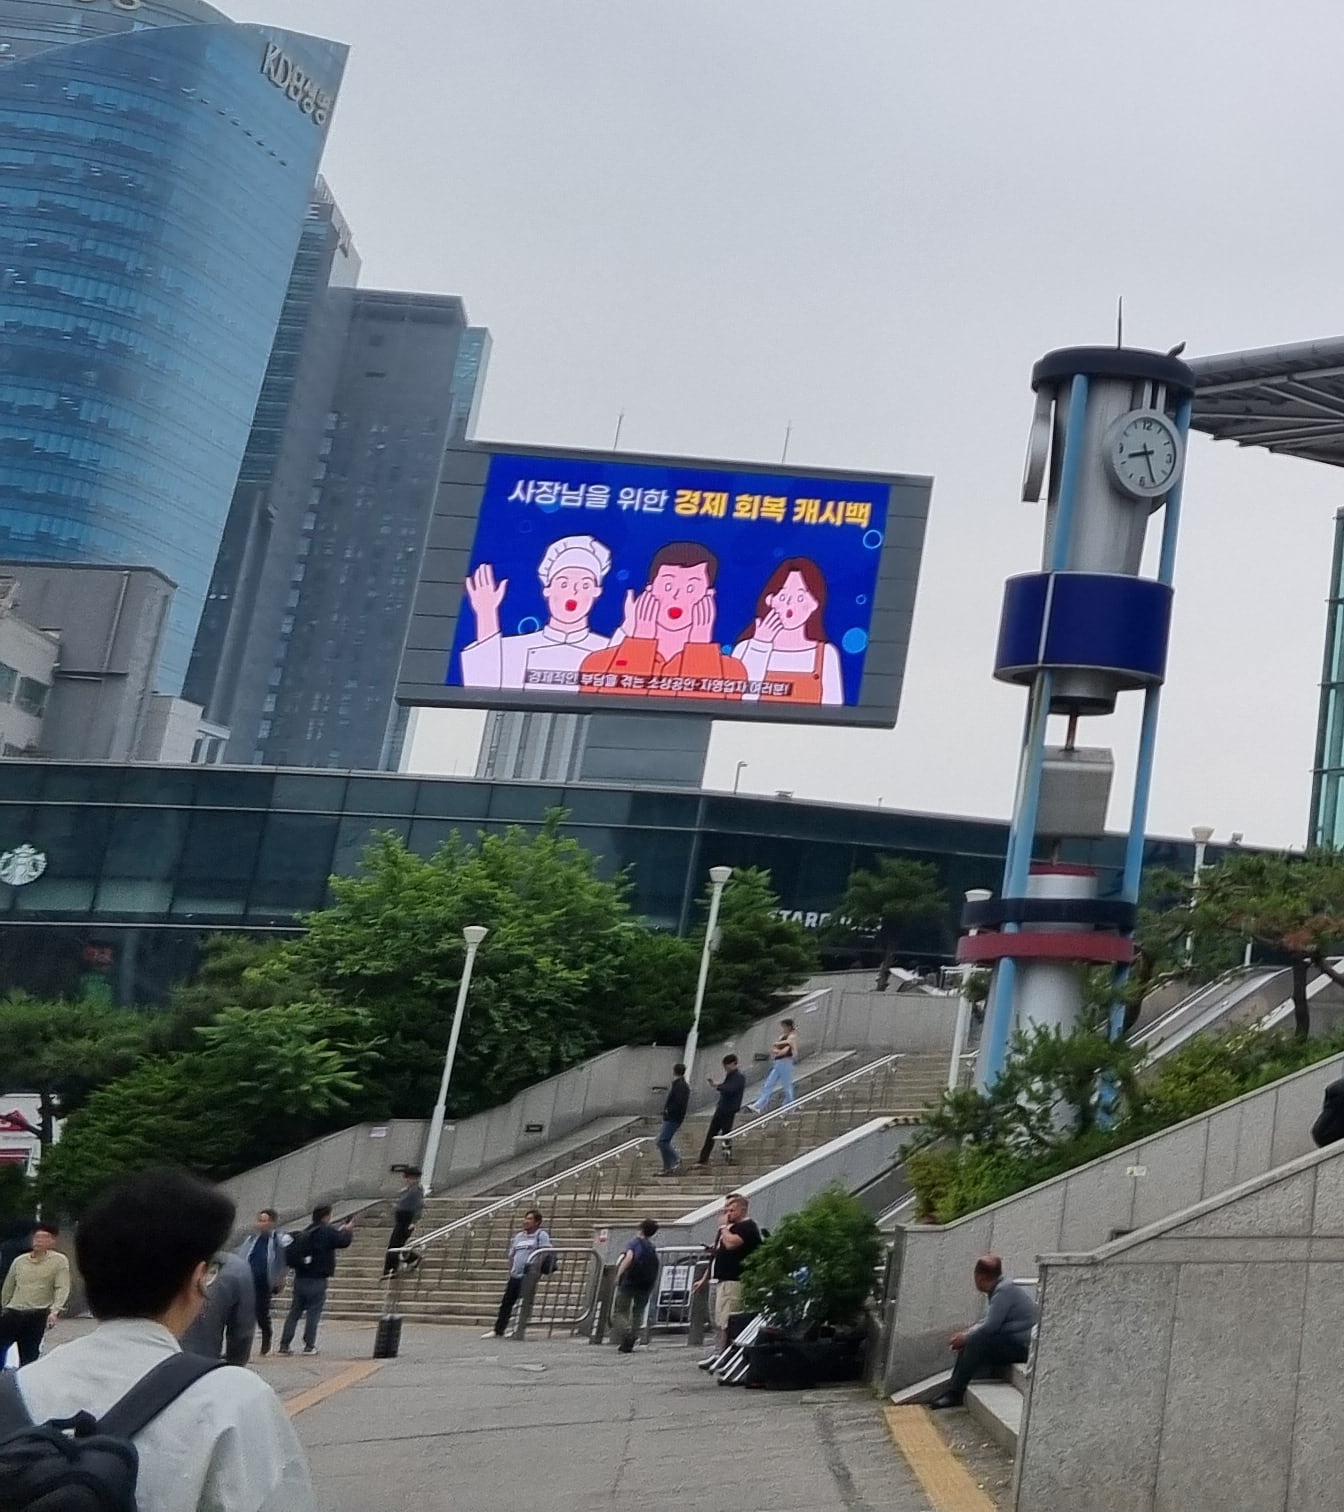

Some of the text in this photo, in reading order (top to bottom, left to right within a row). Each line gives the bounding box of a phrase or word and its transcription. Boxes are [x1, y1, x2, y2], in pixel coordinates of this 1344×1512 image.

[260, 42, 331, 126] KDB생명
[508, 479, 873, 529] 사장님을 위한 경제 회복 캐시백
[528, 669, 579, 685] 경제적인
[580, 673, 618, 689] 부담을
